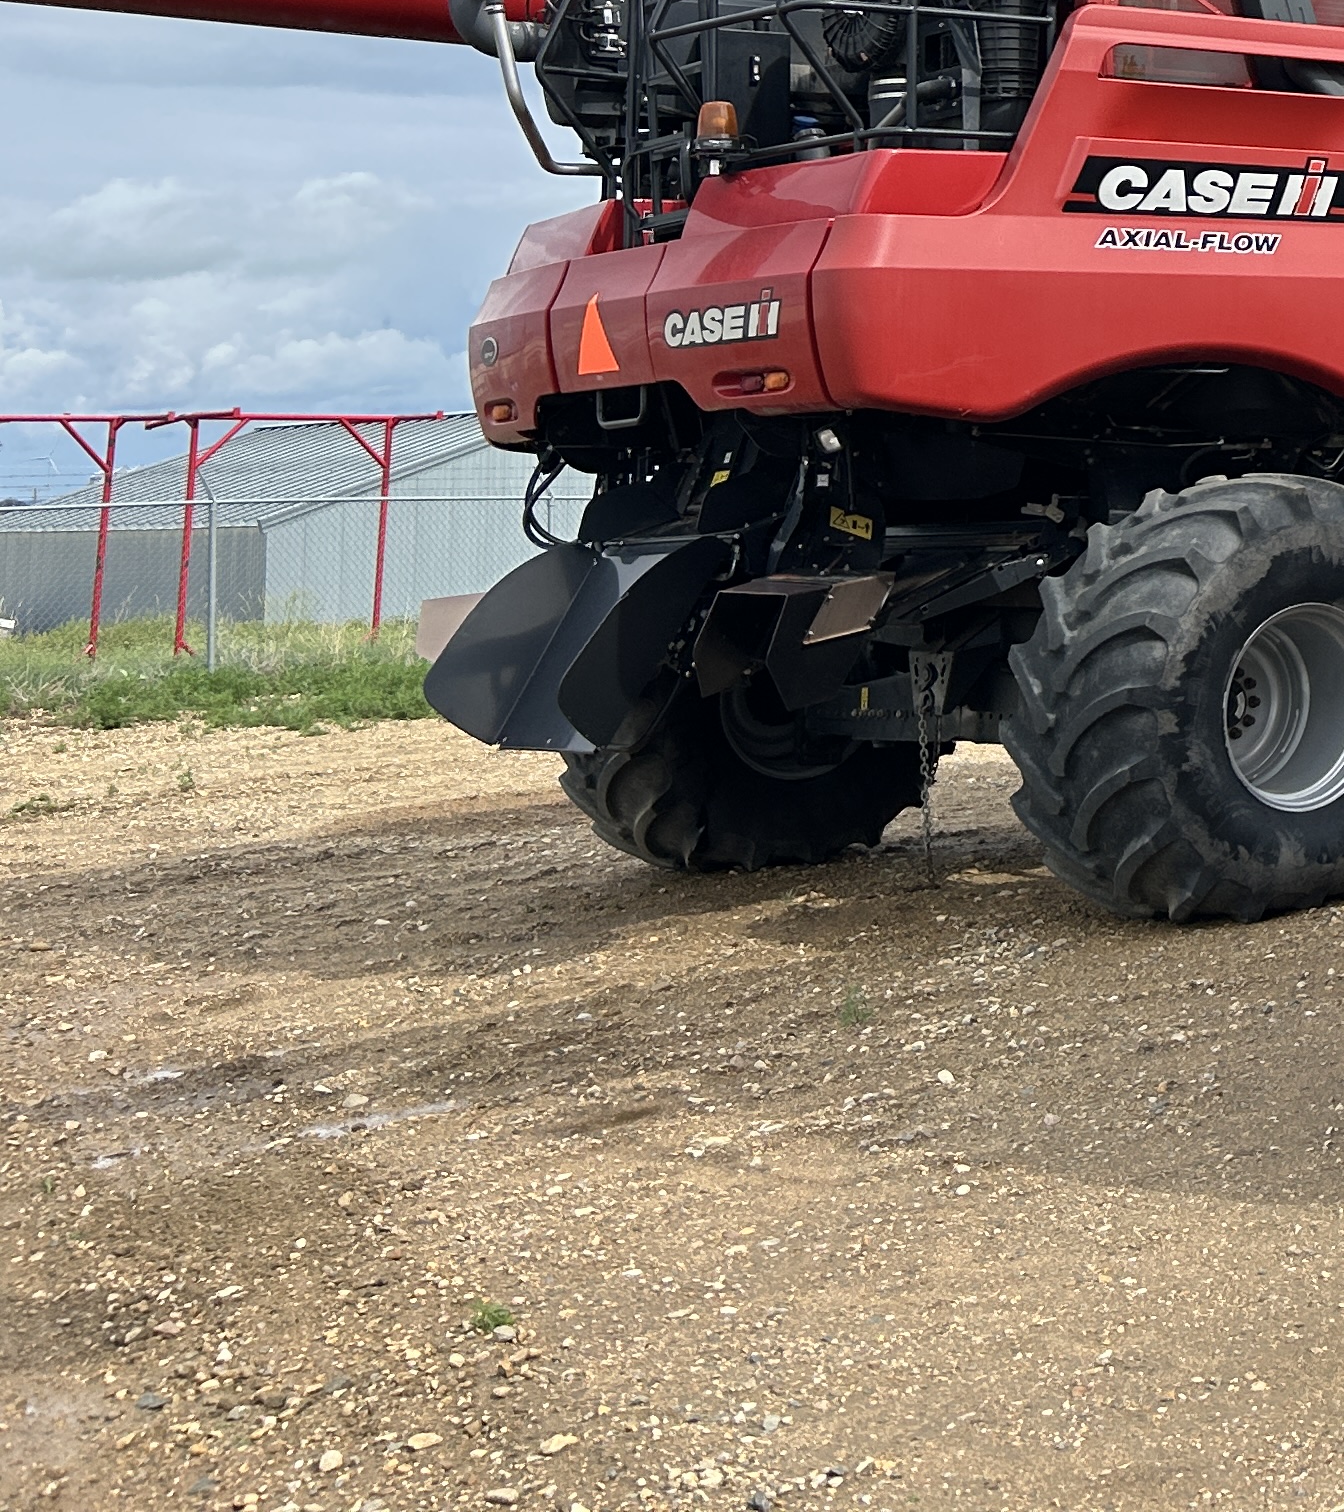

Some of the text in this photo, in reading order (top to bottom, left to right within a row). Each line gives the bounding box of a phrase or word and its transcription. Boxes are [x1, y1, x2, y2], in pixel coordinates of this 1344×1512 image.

[1098, 165, 1279, 216] CASE
[1095, 226, 1283, 255] AXIAL-FLOW
[664, 305, 746, 348] CASE
